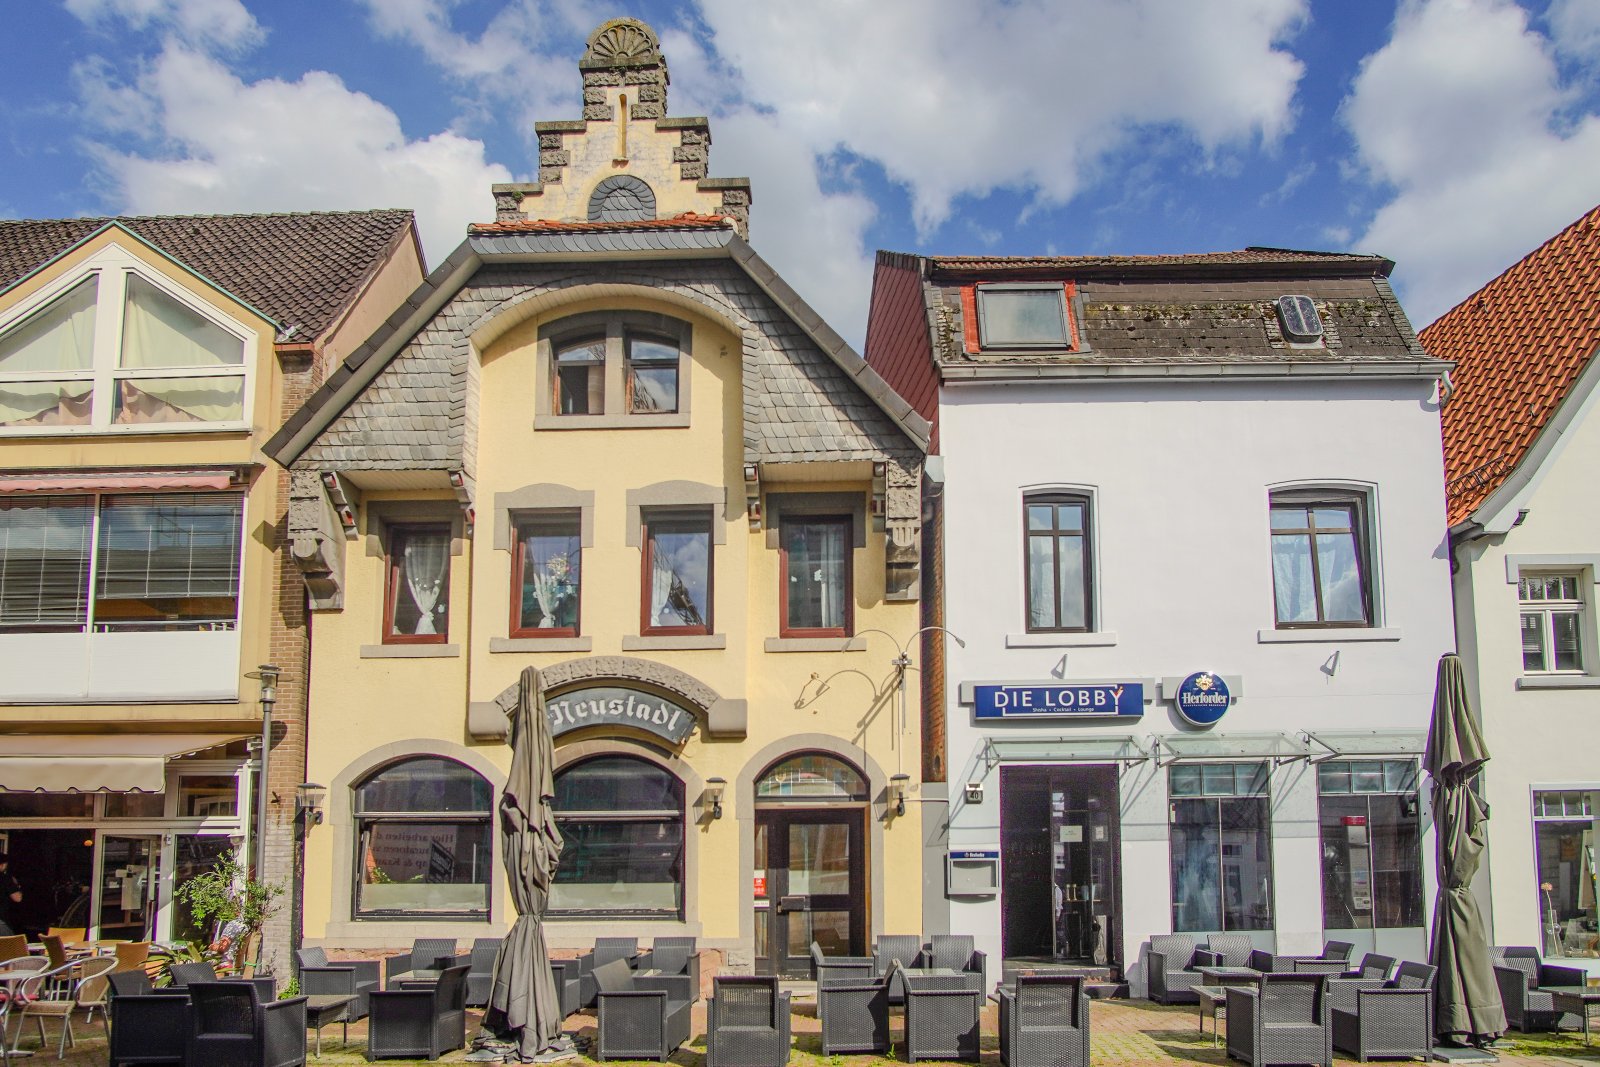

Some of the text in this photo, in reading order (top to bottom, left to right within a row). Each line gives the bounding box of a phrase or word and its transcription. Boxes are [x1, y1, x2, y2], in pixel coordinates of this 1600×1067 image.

[994, 688, 1124, 708] DIE LOBBY
[1181, 691, 1228, 704] Herforder
[970, 791, 979, 800] 40
